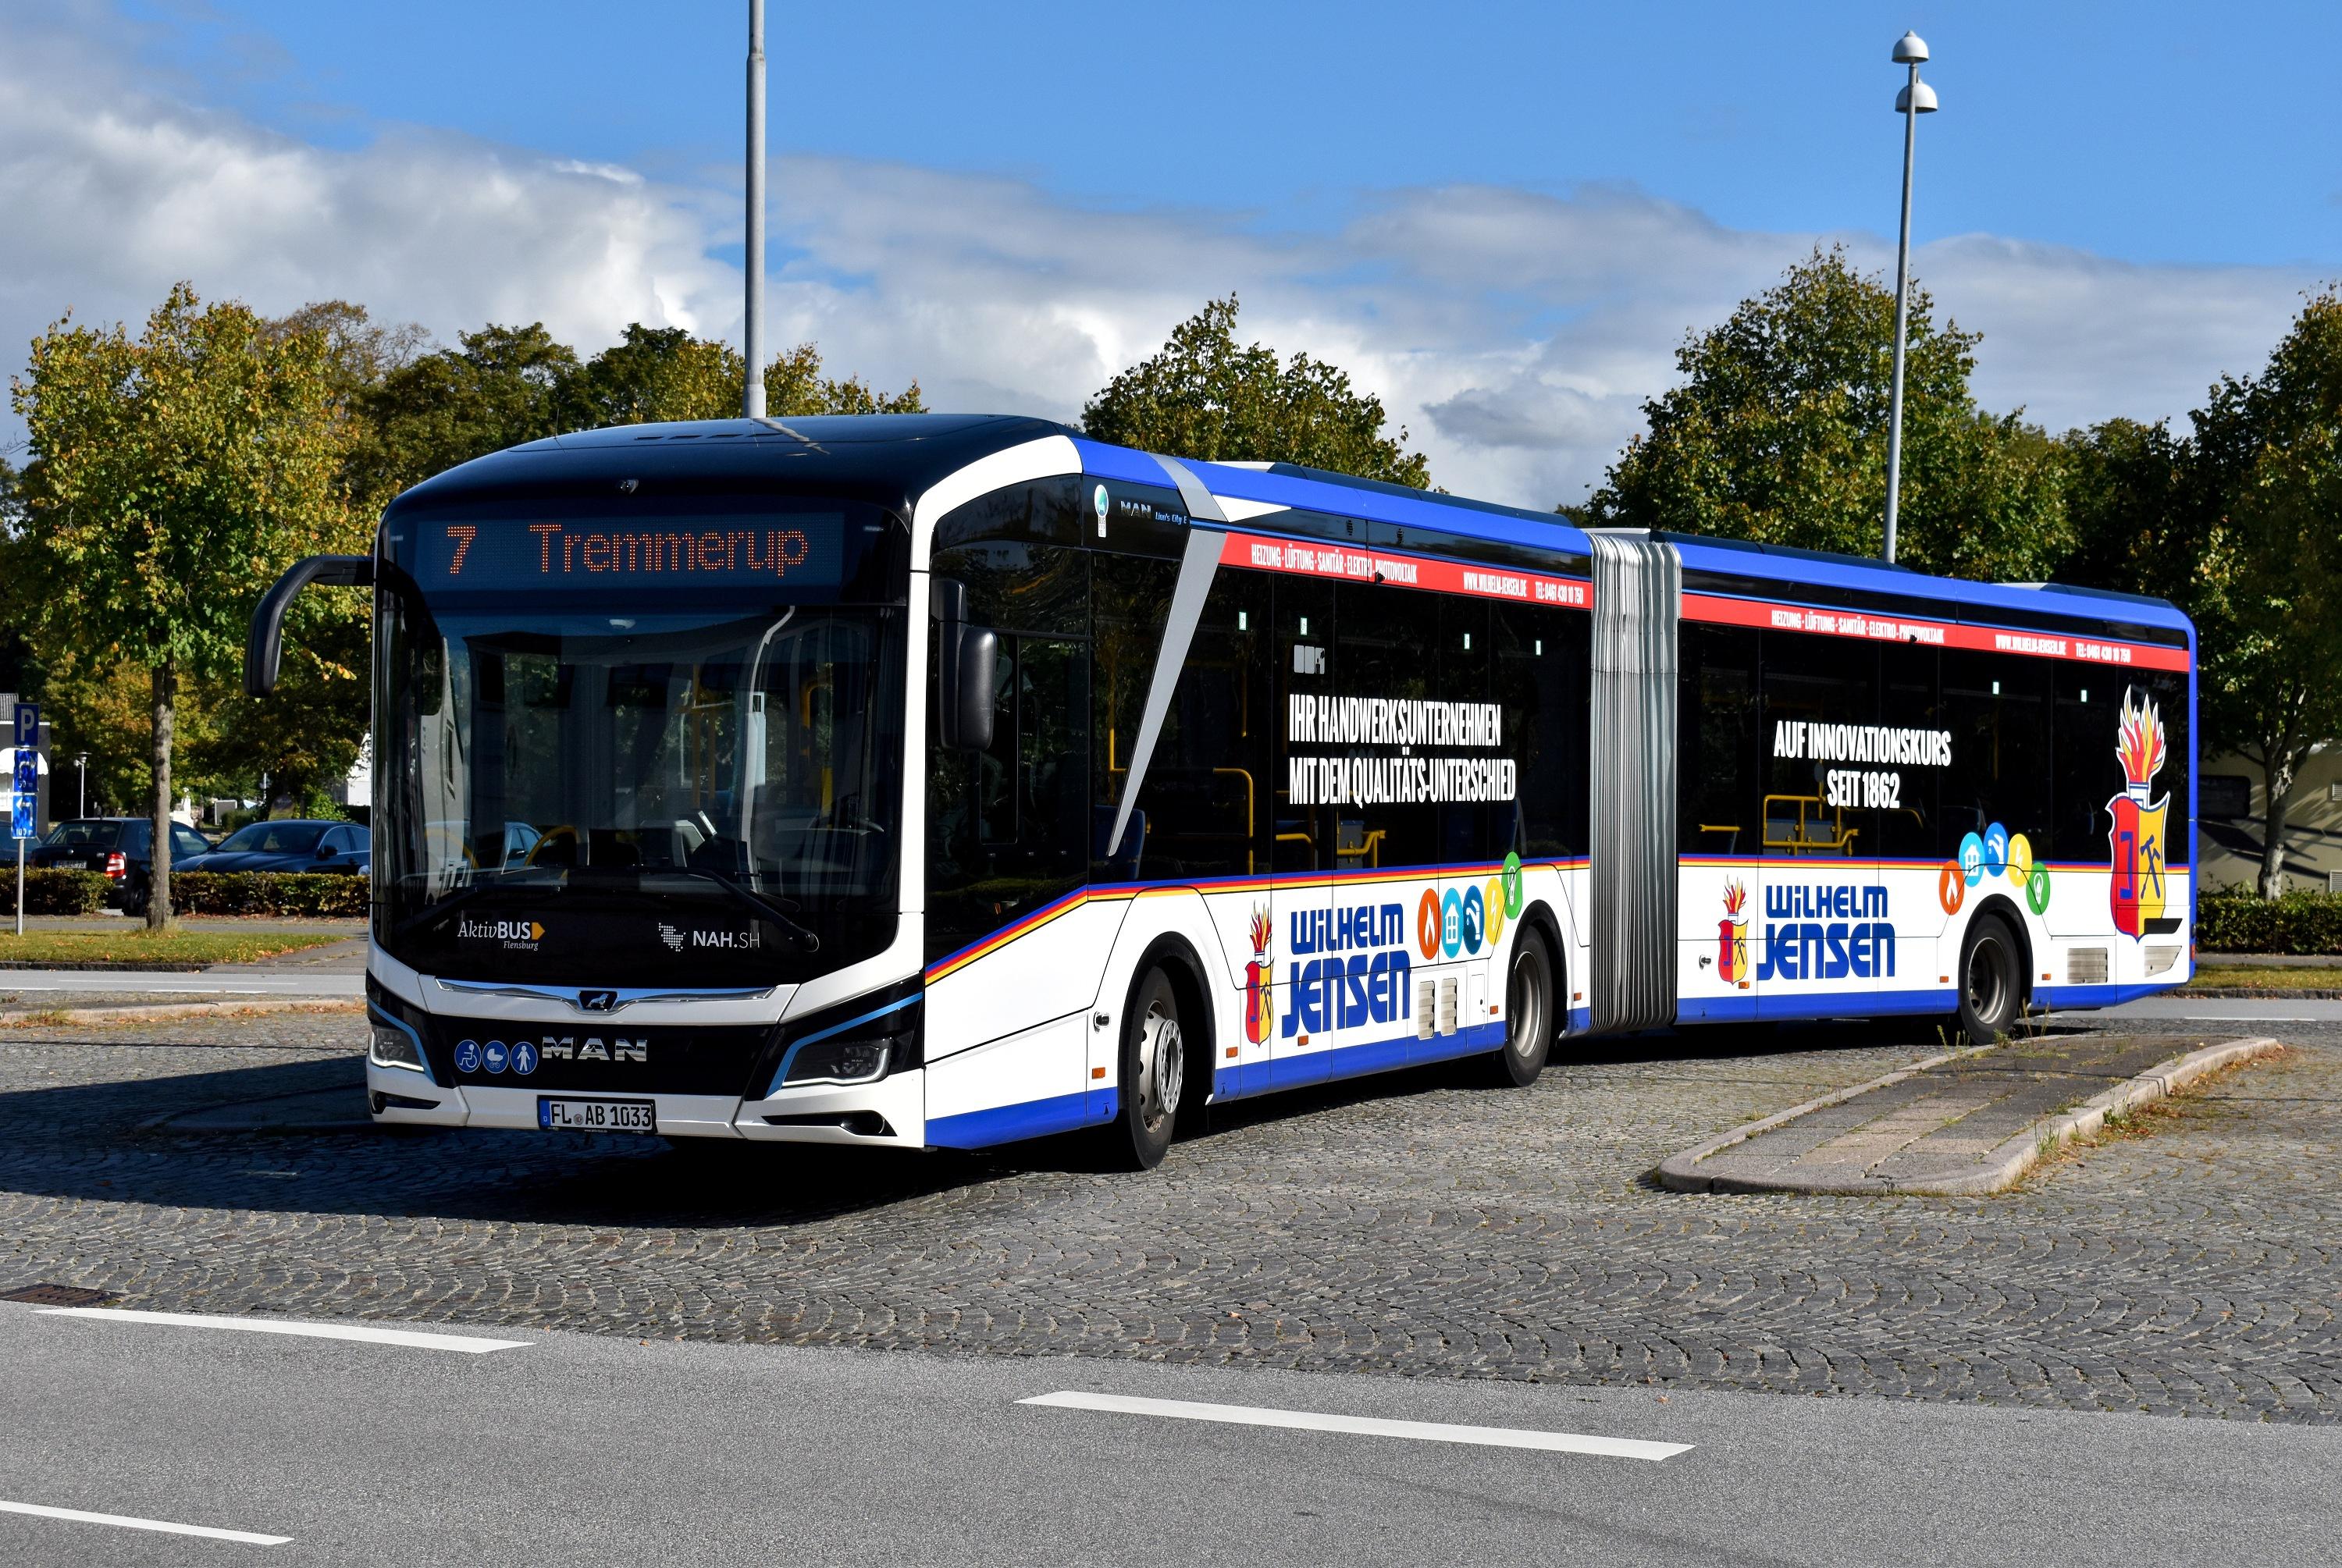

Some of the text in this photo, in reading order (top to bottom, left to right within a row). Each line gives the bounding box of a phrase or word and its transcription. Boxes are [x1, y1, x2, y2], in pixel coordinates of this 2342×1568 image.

[1120, 500, 1151, 518] MAN
[1155, 512, 1170, 521] Lion's
[1172, 514, 1182, 525] City
[447, 524, 809, 577] 7 Tremmerup
[1251, 543, 1418, 584] HEIZUNG LÜFTUNG SANITÄR ELEKTRO PHOTOVOLTAIK
[1771, 610, 1801, 628] HEIZUNG
[1805, 611, 1835, 632] LÜFTUNG
[1838, 616, 1866, 635] SANITÄR
[1869, 620, 1896, 638] ELEKTRO
[20, 709, 34, 741] P
[1290, 693, 1501, 746] IHR HANDWERKSUNTERNEHMEN
[1773, 720, 1952, 766] AUF INNOVATIONSKURS
[1290, 746, 1516, 809] MIT DEM QUALITÄTS-UNTERSCHIED
[1827, 769, 1900, 809] SEIT 1862
[457, 921, 532, 940] AktivBUS
[693, 930, 760, 948] NAH.SH
[504, 940, 539, 951] Flensburg
[543, 1036, 647, 1062] MAN
[550, 1104, 571, 1124] FL
[586, 1104, 606, 1125] AB
[610, 1106, 651, 1127] 1033
